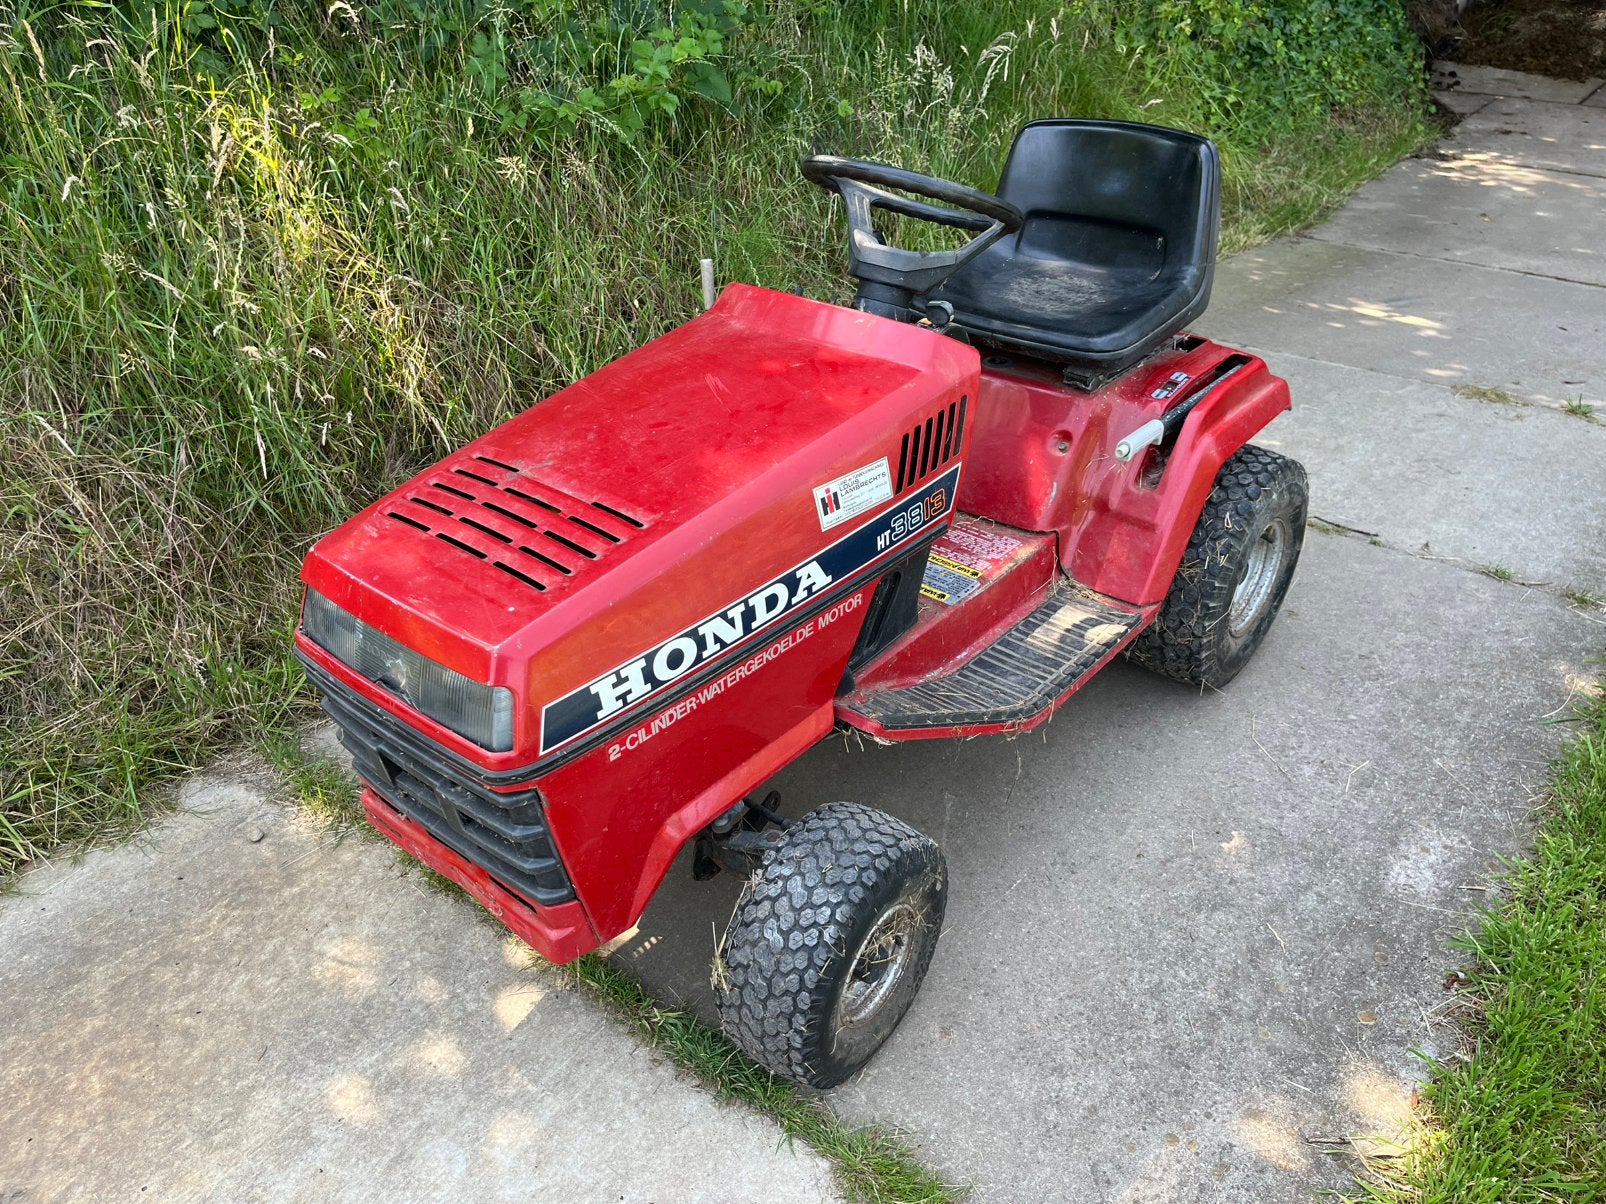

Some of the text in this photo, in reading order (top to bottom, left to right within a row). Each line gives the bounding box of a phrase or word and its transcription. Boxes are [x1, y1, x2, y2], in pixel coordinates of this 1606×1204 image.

[838, 478, 860, 492] LOUIS
[840, 471, 887, 497] LAMBRECHTS
[589, 560, 832, 720] HONDA
[608, 593, 863, 762] 2-CILINDER-WATERGEKOELDE MOTOR
